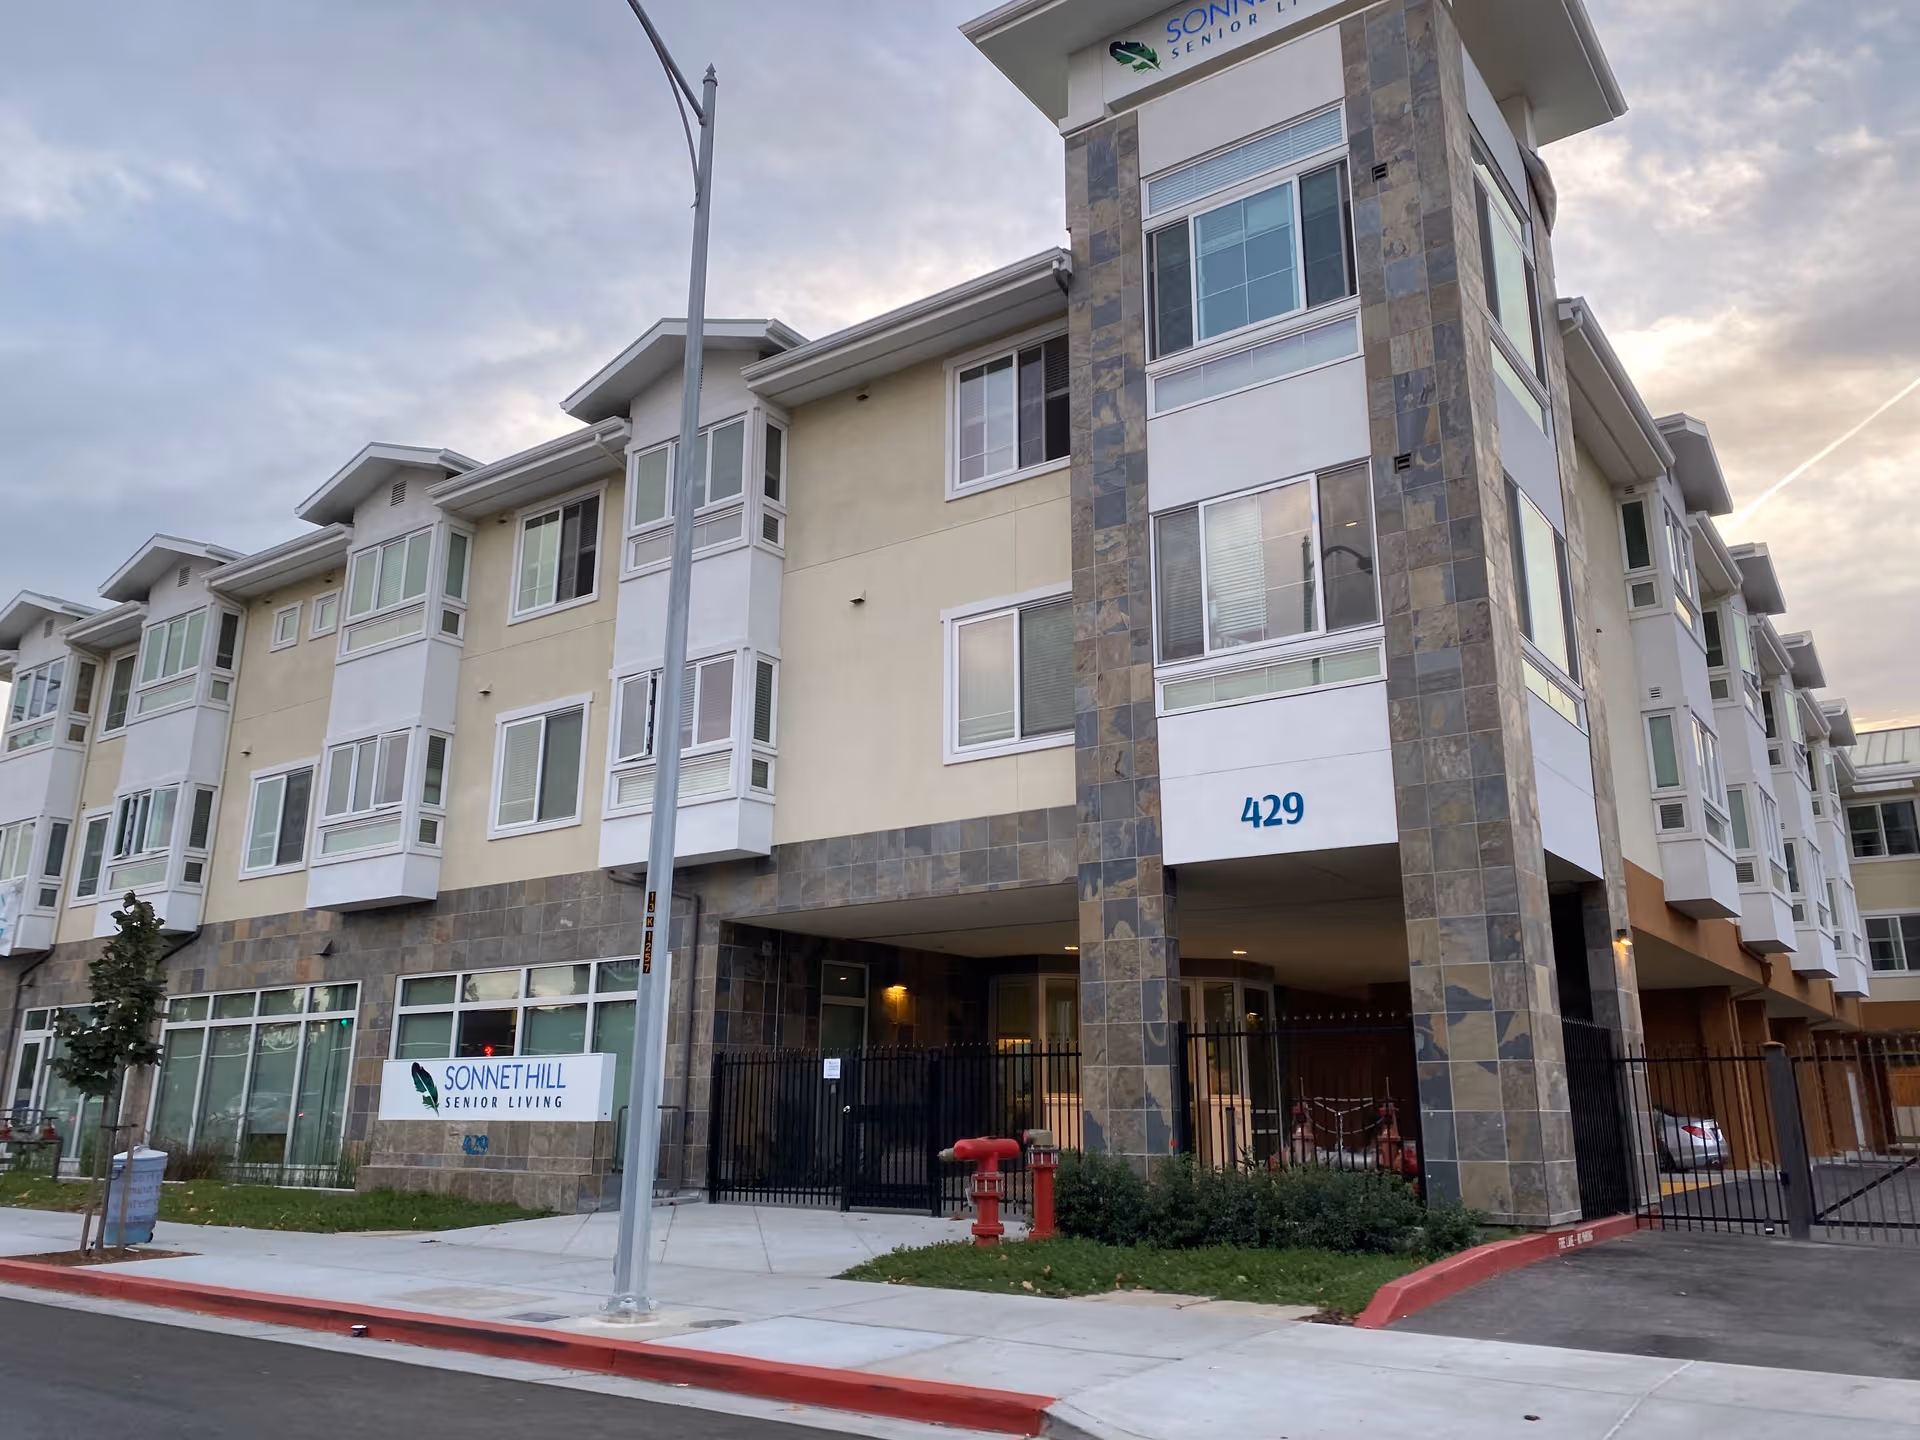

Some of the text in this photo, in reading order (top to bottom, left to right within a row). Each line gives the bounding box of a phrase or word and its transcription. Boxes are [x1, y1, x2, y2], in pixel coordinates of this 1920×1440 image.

[1171, 13, 1258, 60] SENIOR
[1241, 791, 1304, 828] 429
[445, 1095, 562, 1108] SENIOR LIVING
[462, 1134, 488, 1155] 429
